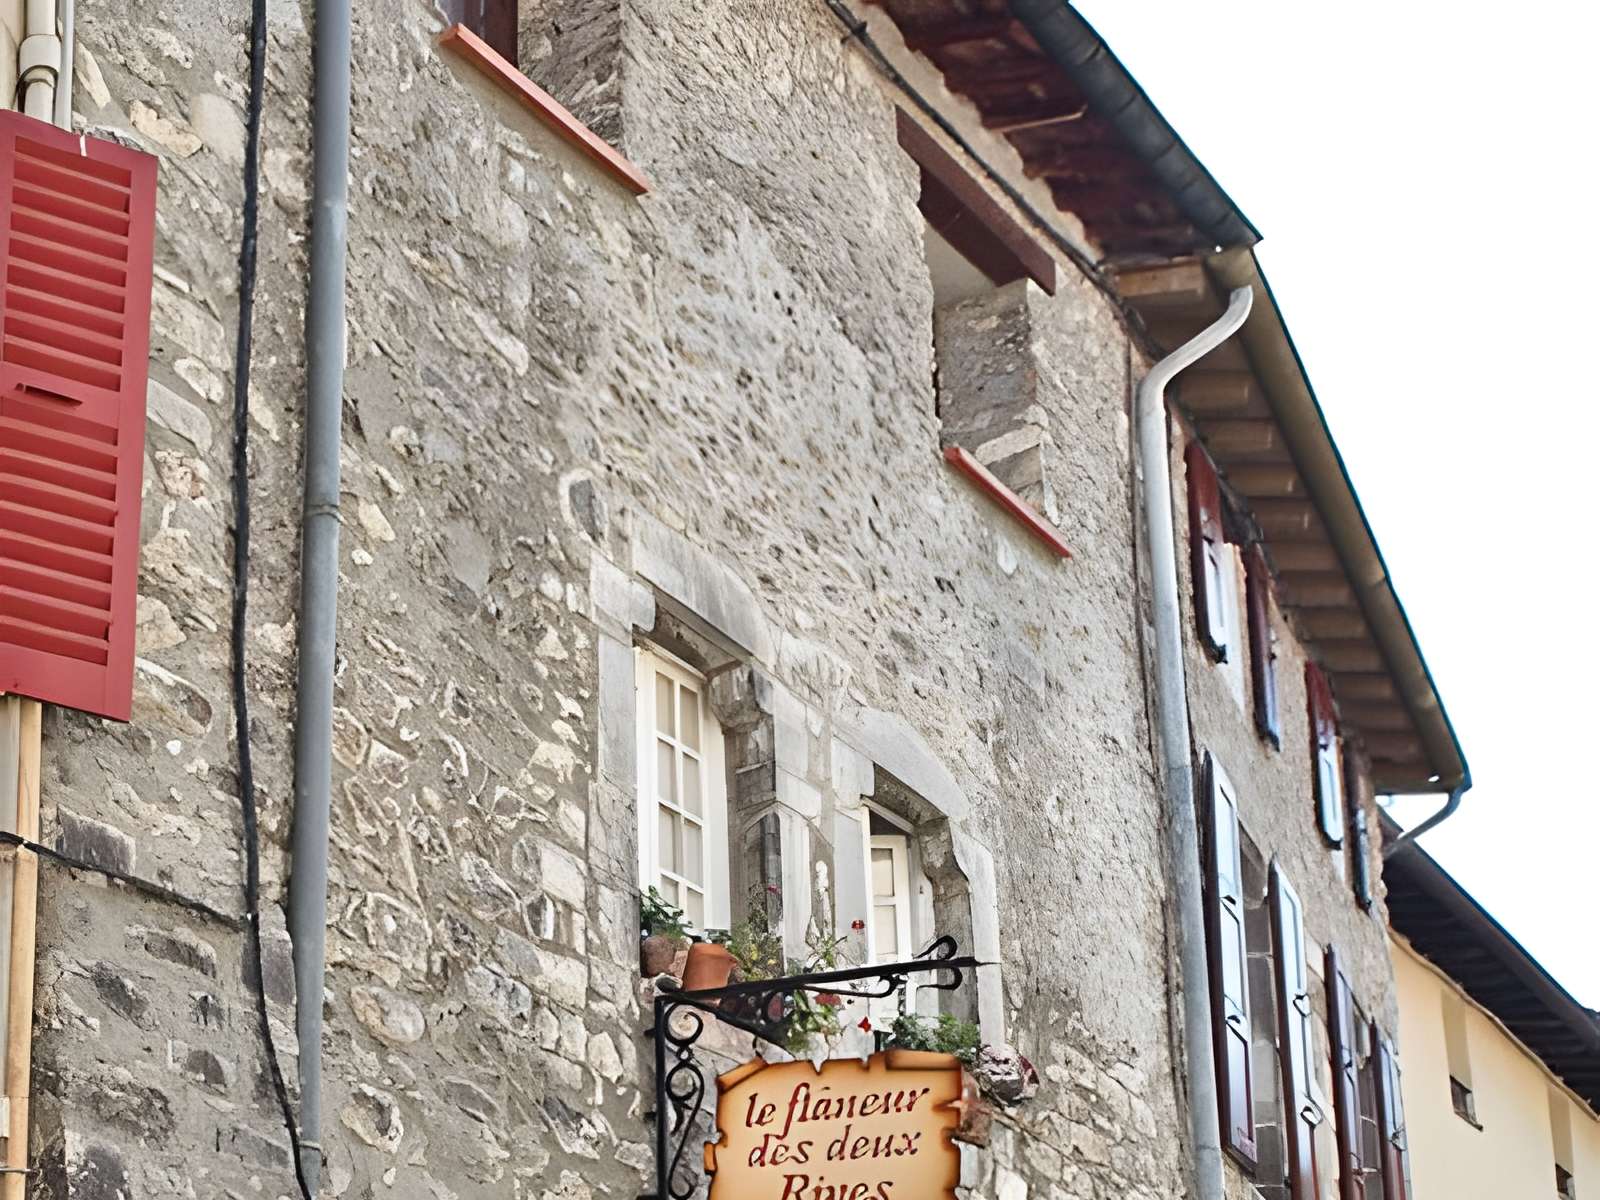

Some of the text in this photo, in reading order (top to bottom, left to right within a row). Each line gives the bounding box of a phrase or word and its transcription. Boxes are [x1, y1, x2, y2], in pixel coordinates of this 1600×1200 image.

[745, 1093, 777, 1128] le
[748, 1124, 922, 1167] des deux
